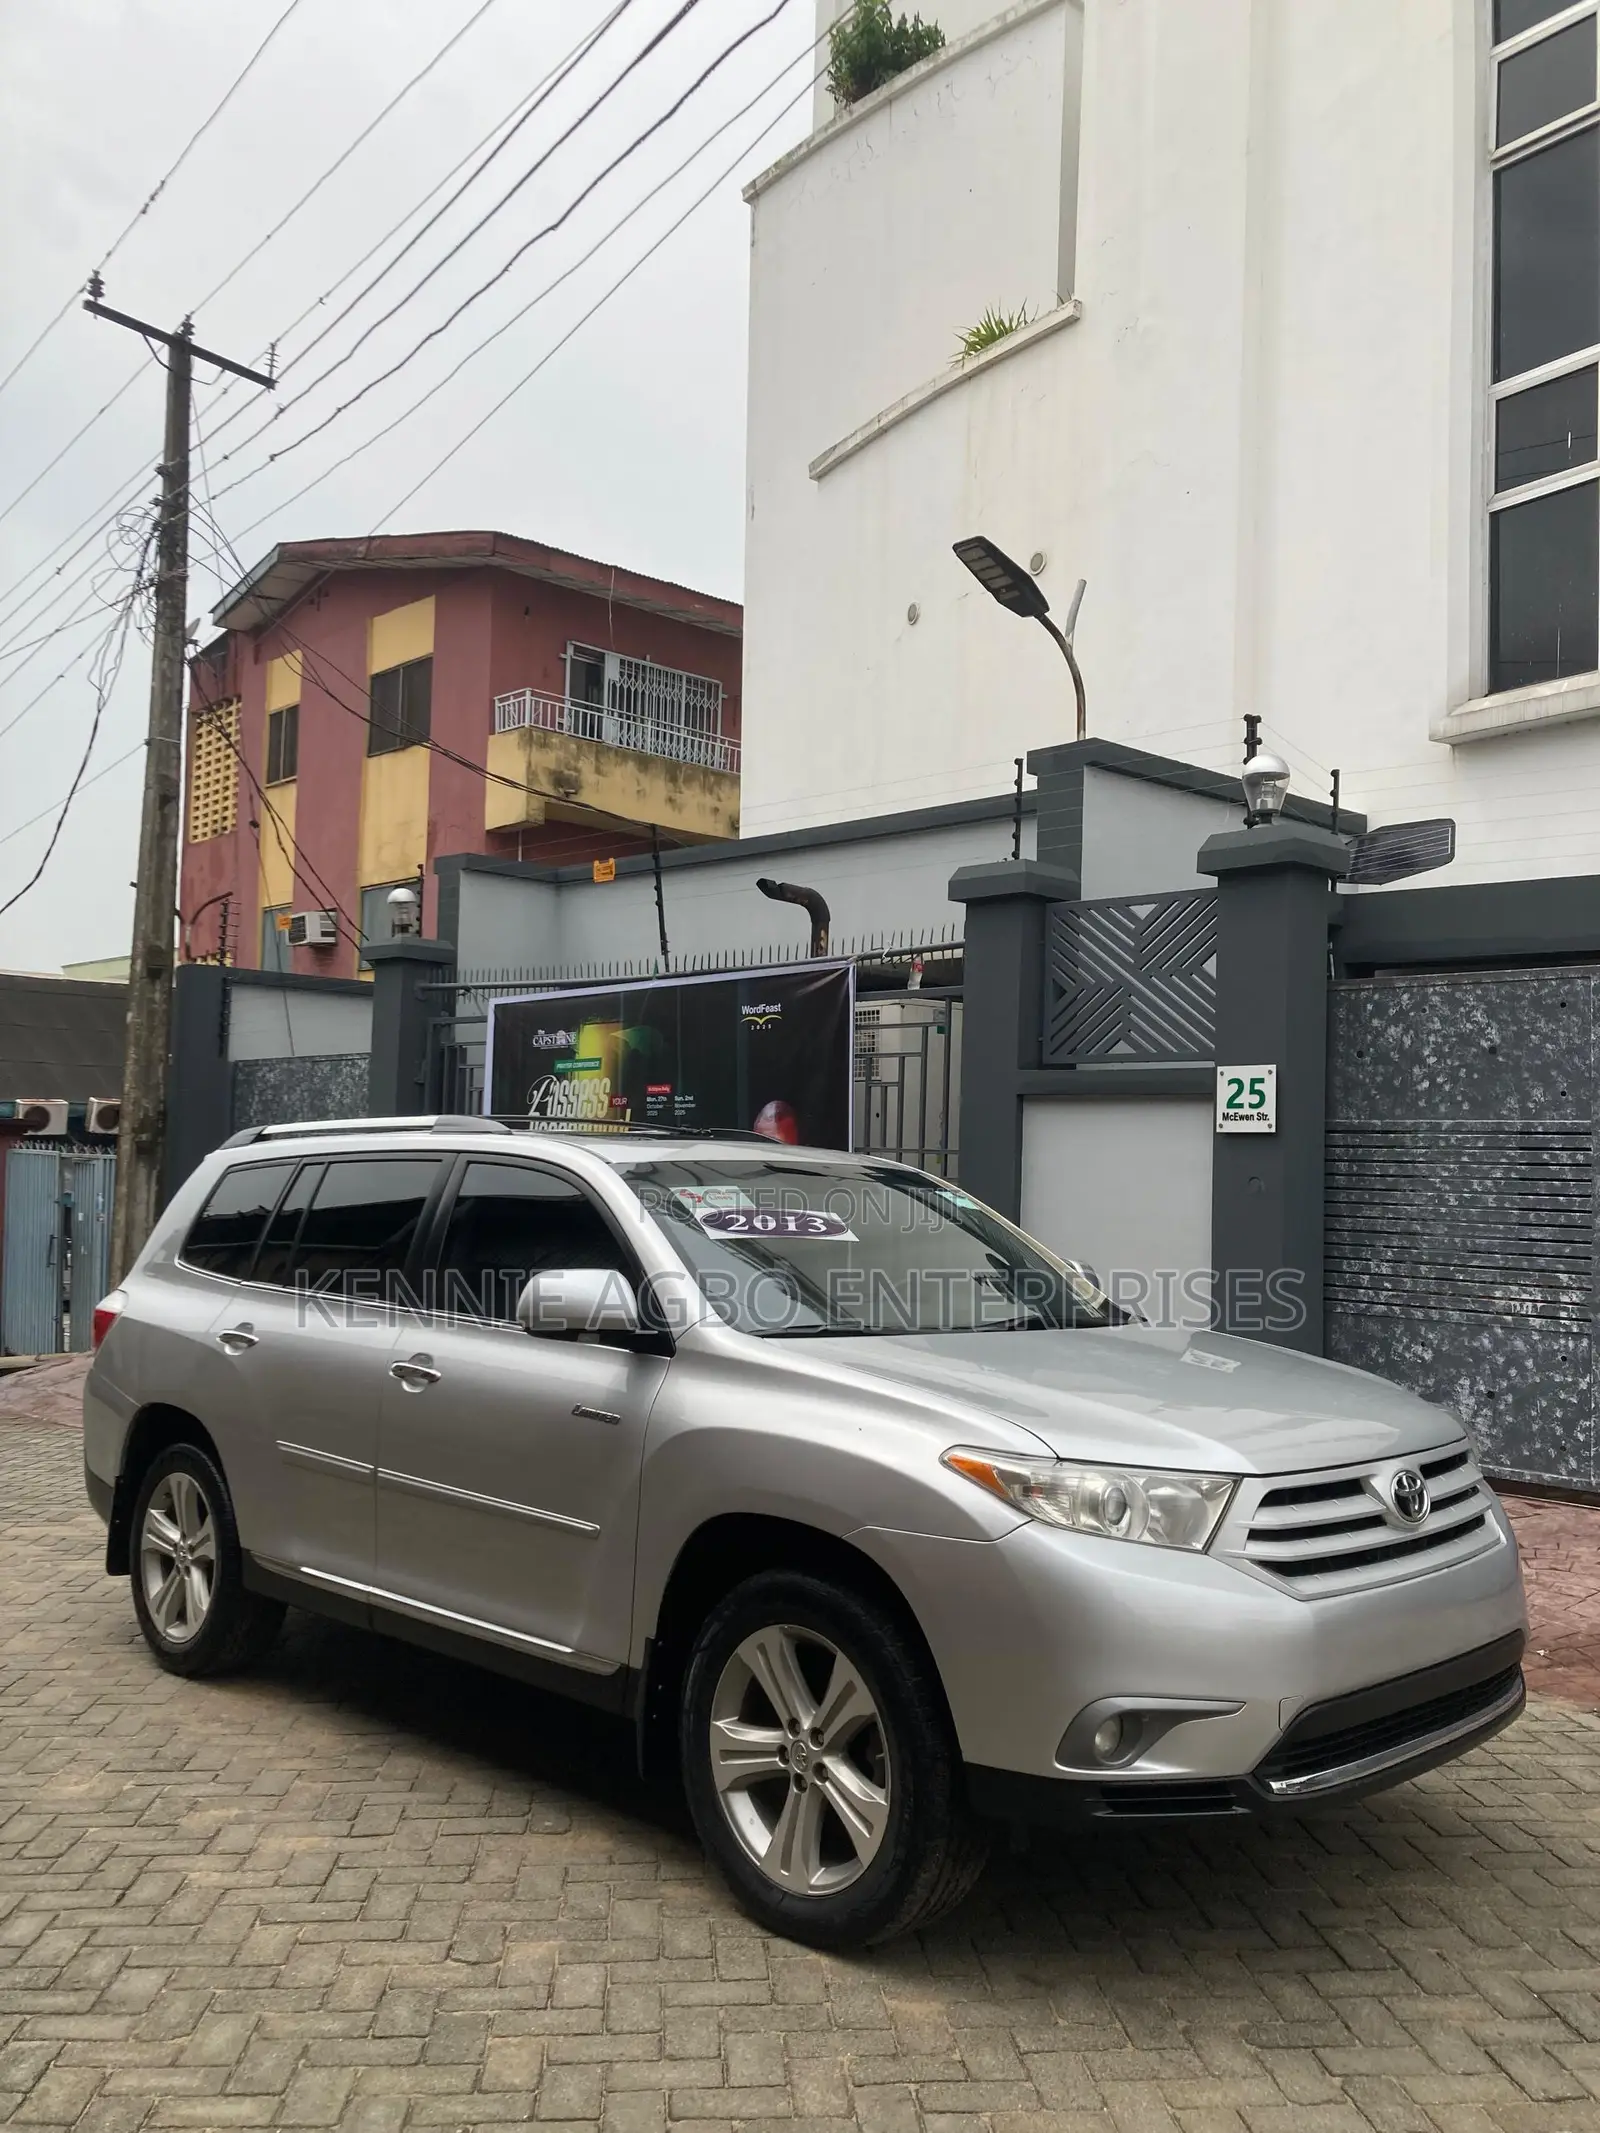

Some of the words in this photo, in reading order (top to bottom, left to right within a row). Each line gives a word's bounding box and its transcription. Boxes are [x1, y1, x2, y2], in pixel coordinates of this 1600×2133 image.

[741, 1003, 782, 1015] WordFeast
[1226, 1077, 1266, 1110] 25
[612, 1097, 627, 1106] YOUR
[1222, 1111, 1255, 1122] McEwen
[1256, 1111, 1270, 1122] Str.
[724, 1214, 828, 1233] 2013
